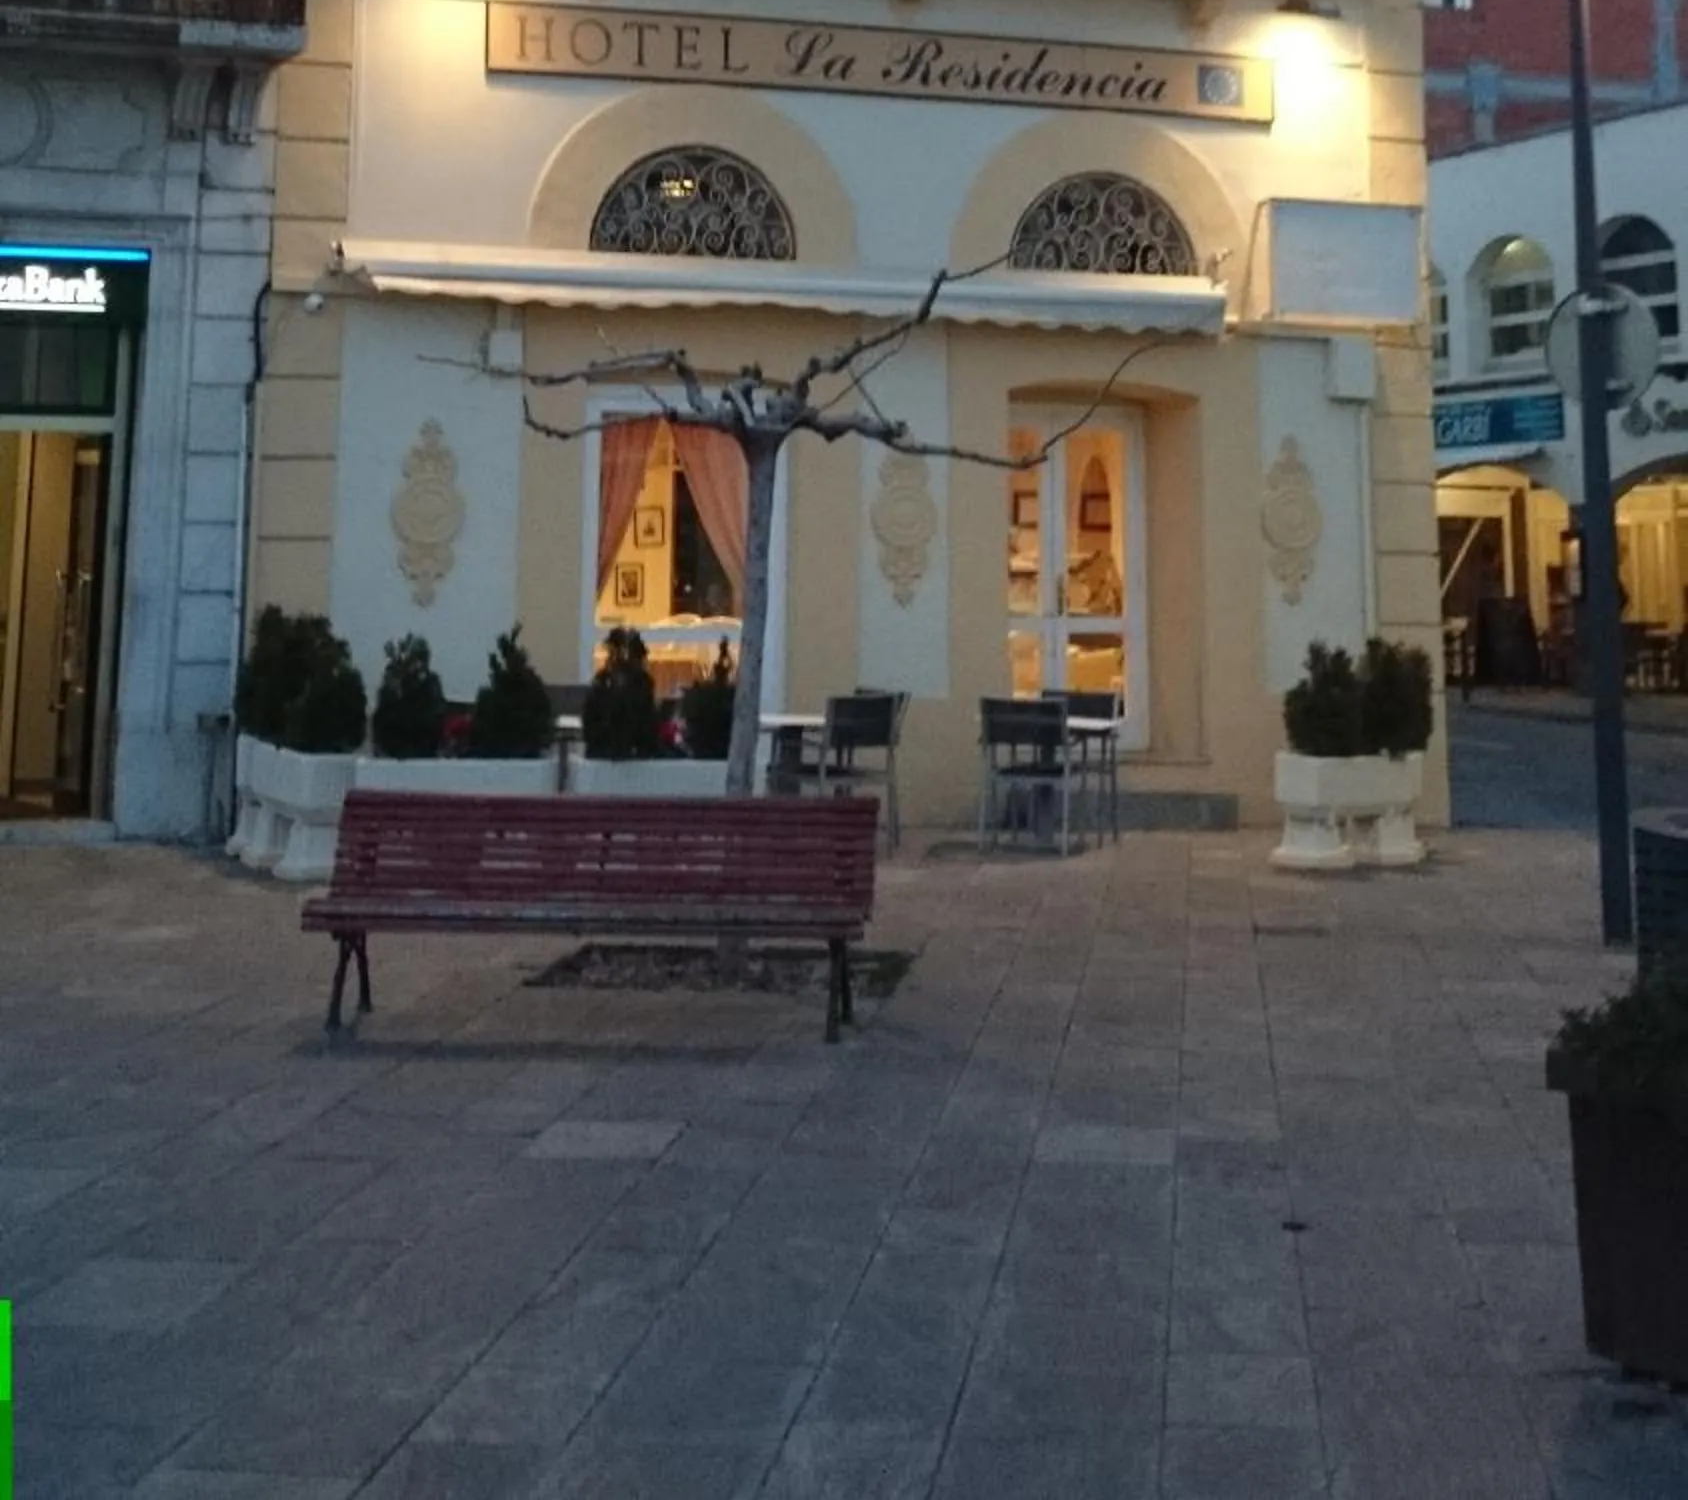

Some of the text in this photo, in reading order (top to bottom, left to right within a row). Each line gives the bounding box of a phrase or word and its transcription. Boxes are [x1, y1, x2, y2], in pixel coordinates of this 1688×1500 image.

[515, 15, 1168, 102] HOTEL La Residencia
